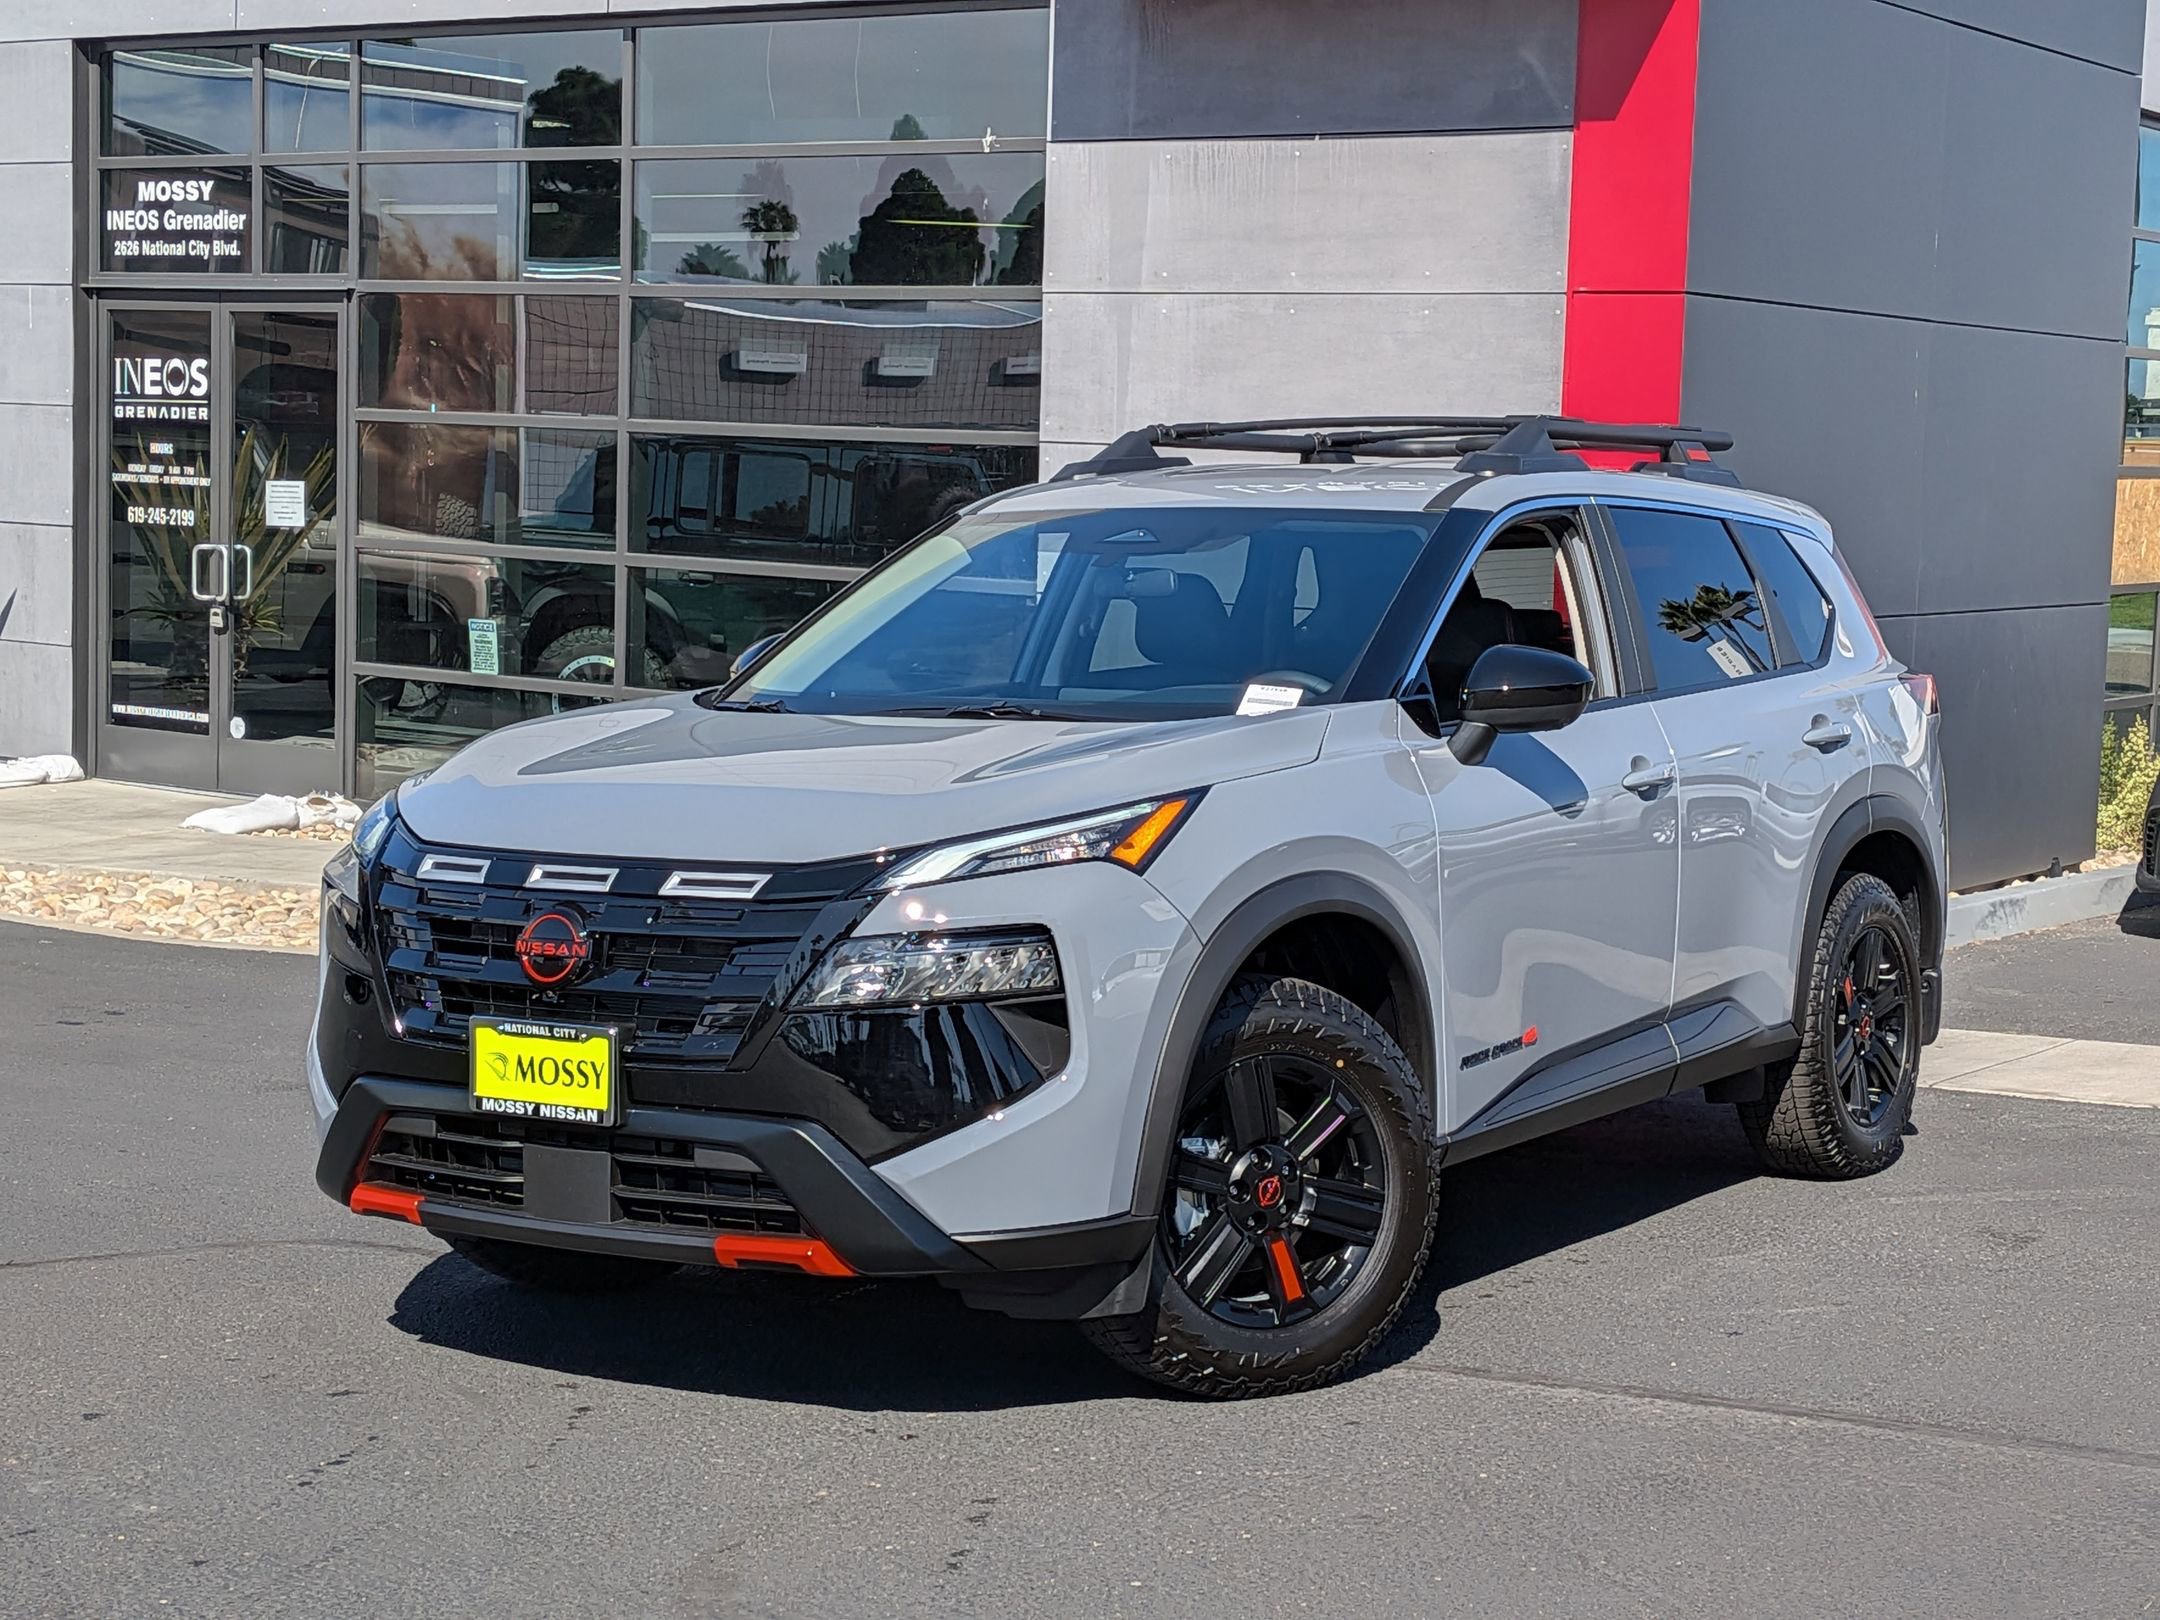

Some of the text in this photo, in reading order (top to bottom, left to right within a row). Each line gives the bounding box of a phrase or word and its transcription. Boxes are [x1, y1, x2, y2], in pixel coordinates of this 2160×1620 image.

[138, 180, 214, 202] MOSSY
[106, 208, 247, 231] INEOS Grenadier
[114, 239, 241, 260] 2626 National City Blvd.
[114, 357, 208, 396] INEOS
[114, 405, 209, 420] GRENADIER
[127, 506, 195, 527] 619-245-2199
[515, 939, 588, 958] NISSAN
[504, 1023, 577, 1038] NATIONAL CITY
[514, 1053, 605, 1090] MOSSY
[481, 1097, 599, 1123] MOSSY NISSAN
